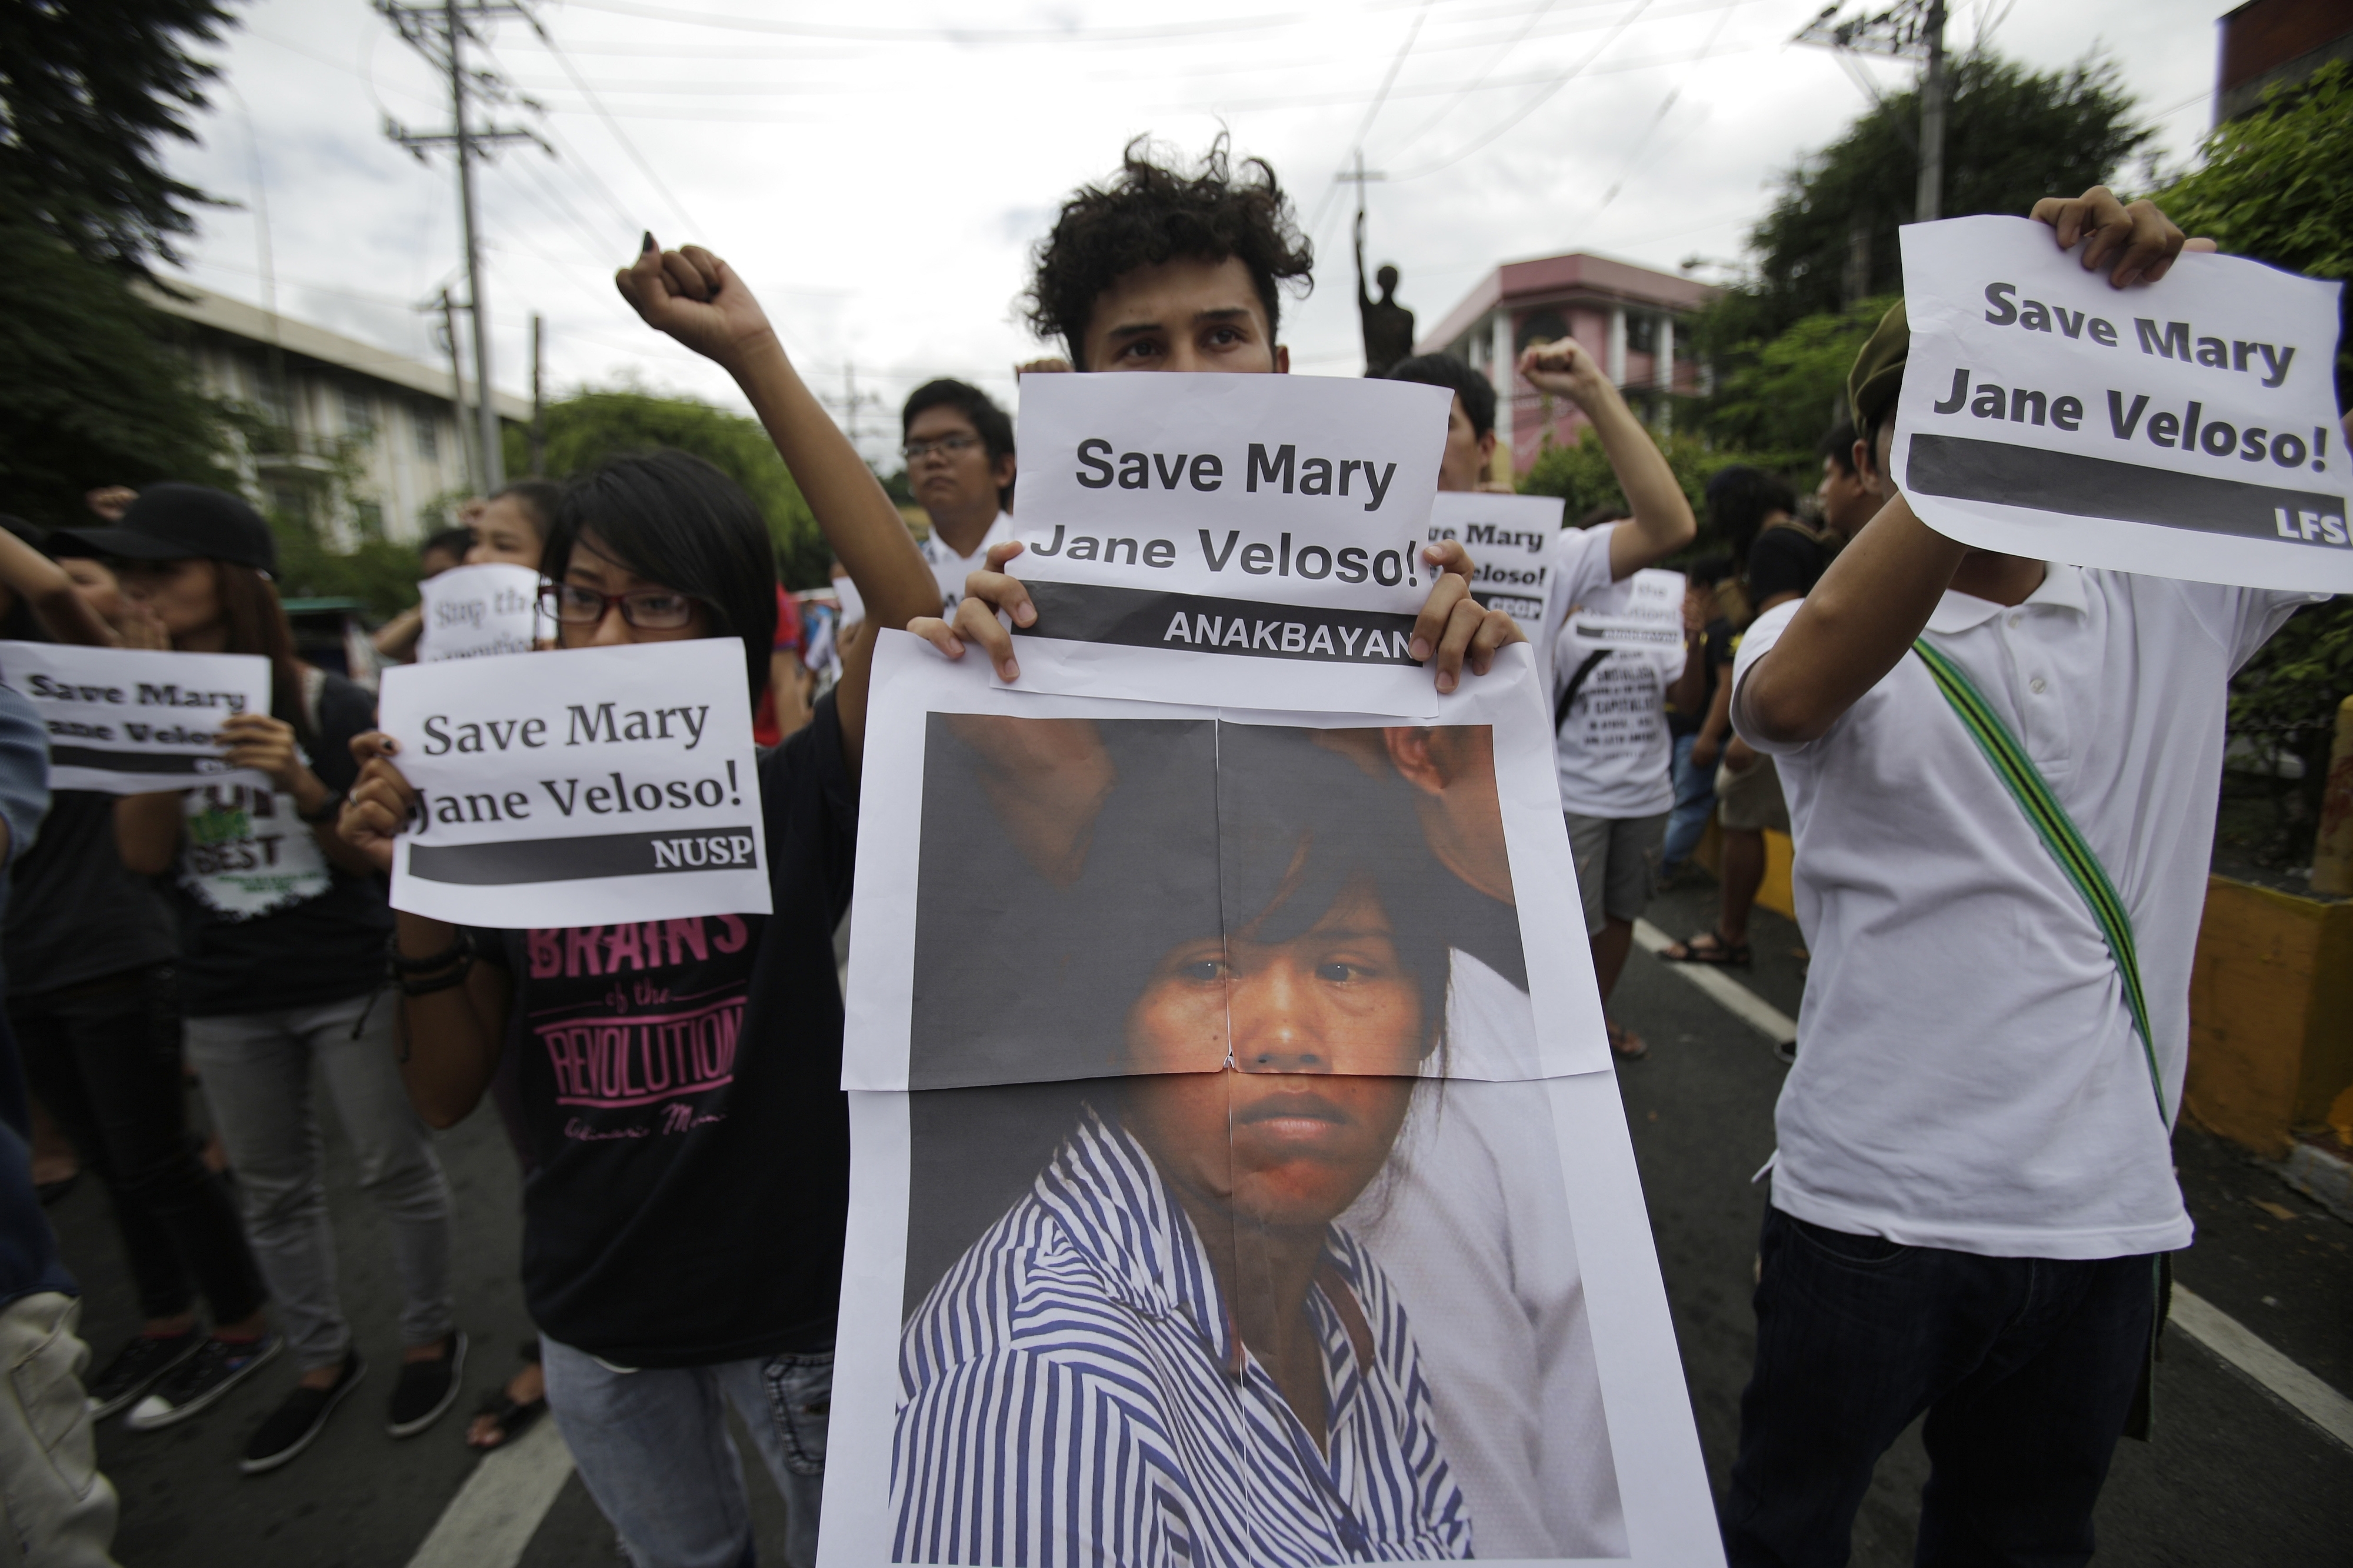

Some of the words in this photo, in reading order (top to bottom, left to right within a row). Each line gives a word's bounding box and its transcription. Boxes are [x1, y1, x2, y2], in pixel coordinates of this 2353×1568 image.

[1984, 282, 2118, 348] Save
[2134, 318, 2295, 388] Mary
[1934, 369, 2082, 431] Jane
[2106, 389, 2328, 473] Veloso!
[1076, 439, 1222, 492] Save
[1247, 443, 1397, 511] Mary
[1428, 525, 1457, 541] ve
[1467, 523, 1544, 553] Mary
[2272, 505, 2347, 548] LFS
[1031, 525, 1175, 568] Jane
[1198, 529, 1417, 586] Veloso!
[1472, 563, 1547, 586] eloso!
[1164, 612, 1413, 659] ANAKBAYAN
[28, 674, 125, 703] Save
[136, 682, 246, 714] Mary
[47, 719, 114, 740] ane
[423, 715, 547, 756] Save
[567, 703, 709, 749] Mary
[413, 787, 529, 835] Jane
[540, 760, 741, 816] Veloso!
[651, 834, 754, 869] NUSP
[605, 982, 628, 1014] of
[634, 978, 671, 1006] the
[544, 1006, 743, 1097] REVOLUTION
